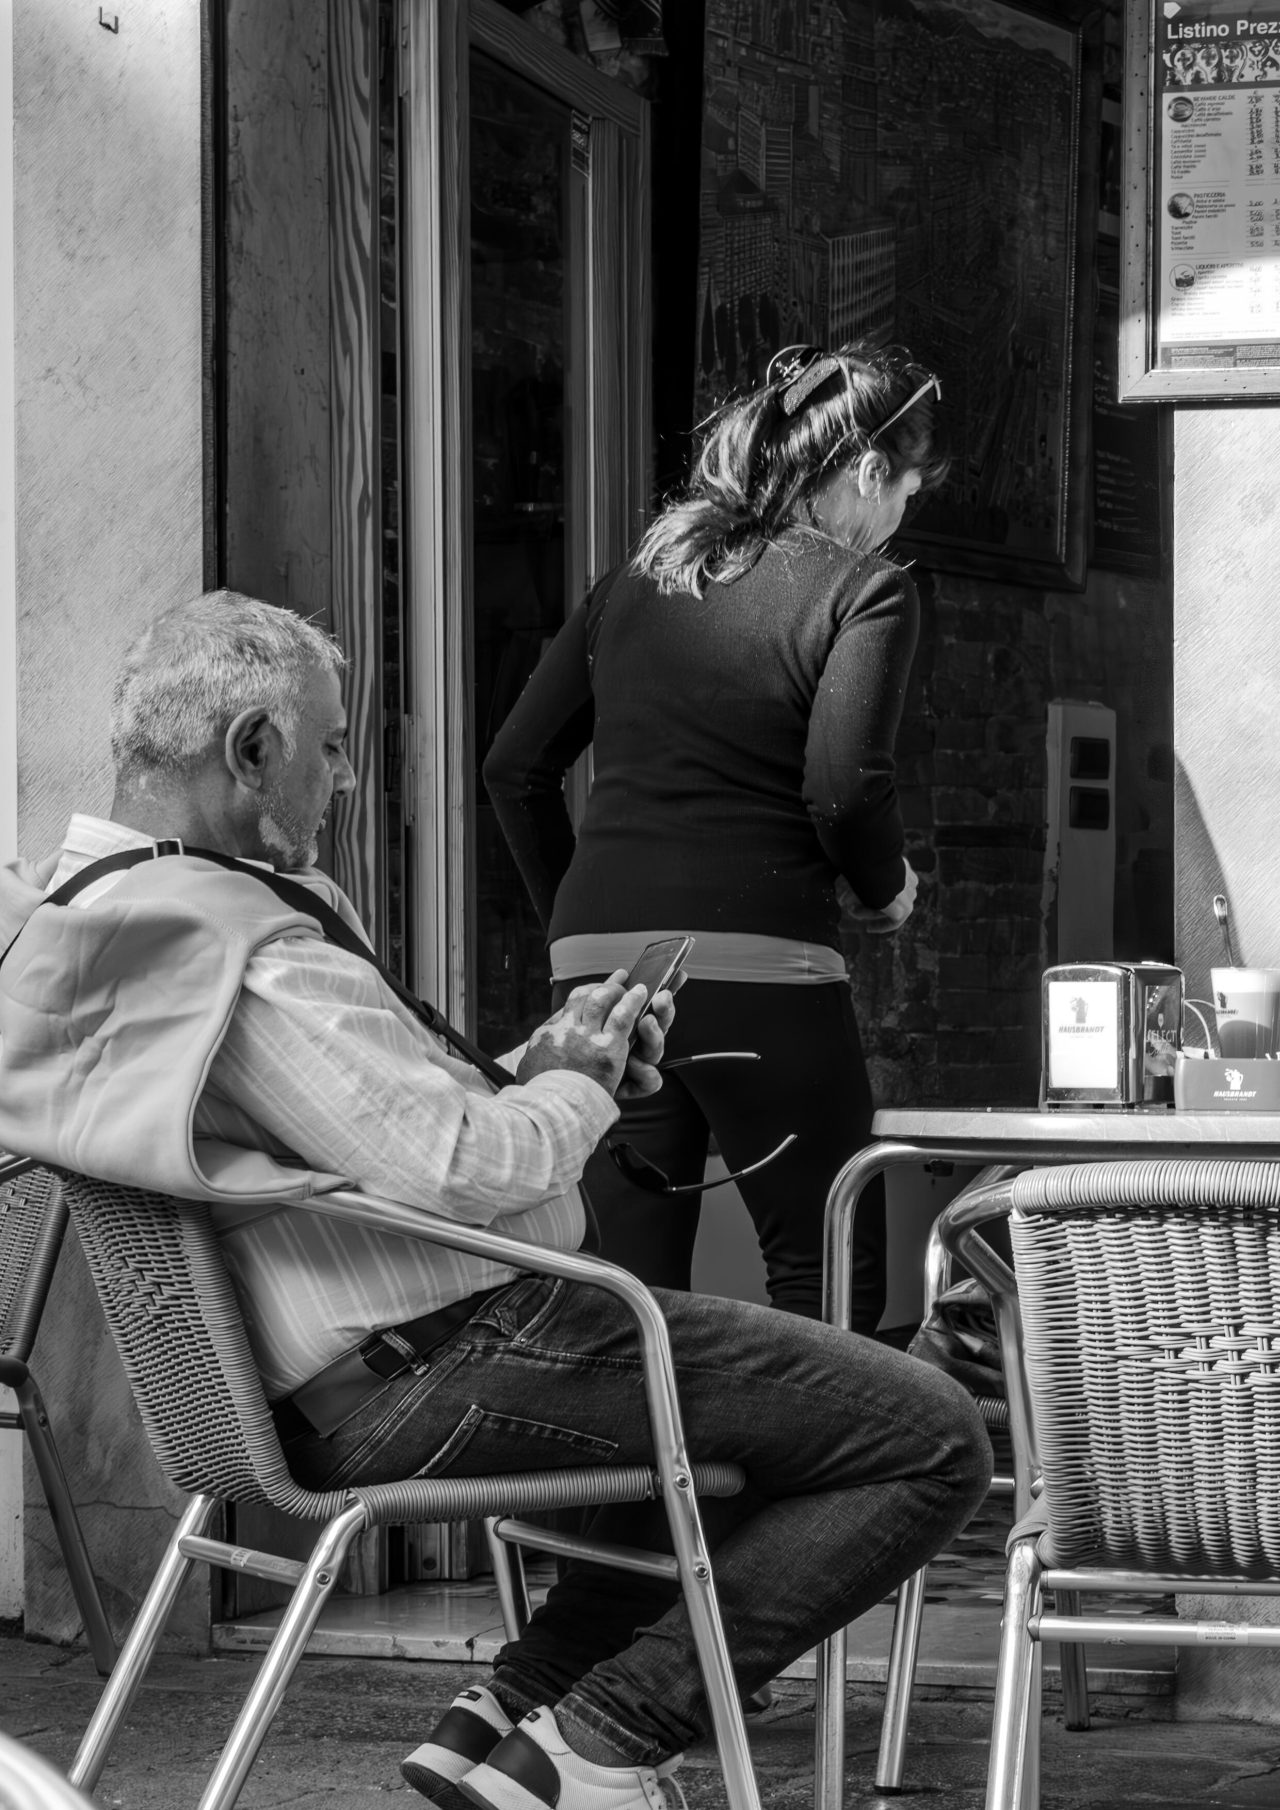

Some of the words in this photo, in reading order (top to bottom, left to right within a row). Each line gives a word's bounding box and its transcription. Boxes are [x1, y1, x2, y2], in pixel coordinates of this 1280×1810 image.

[1167, 20, 1230, 40] Listino
[1058, 1025, 1105, 1034] HAUSBRANDT
[1146, 1029, 1177, 1043] SELECT
[1213, 1090, 1257, 1098] HAUSBRANDT
